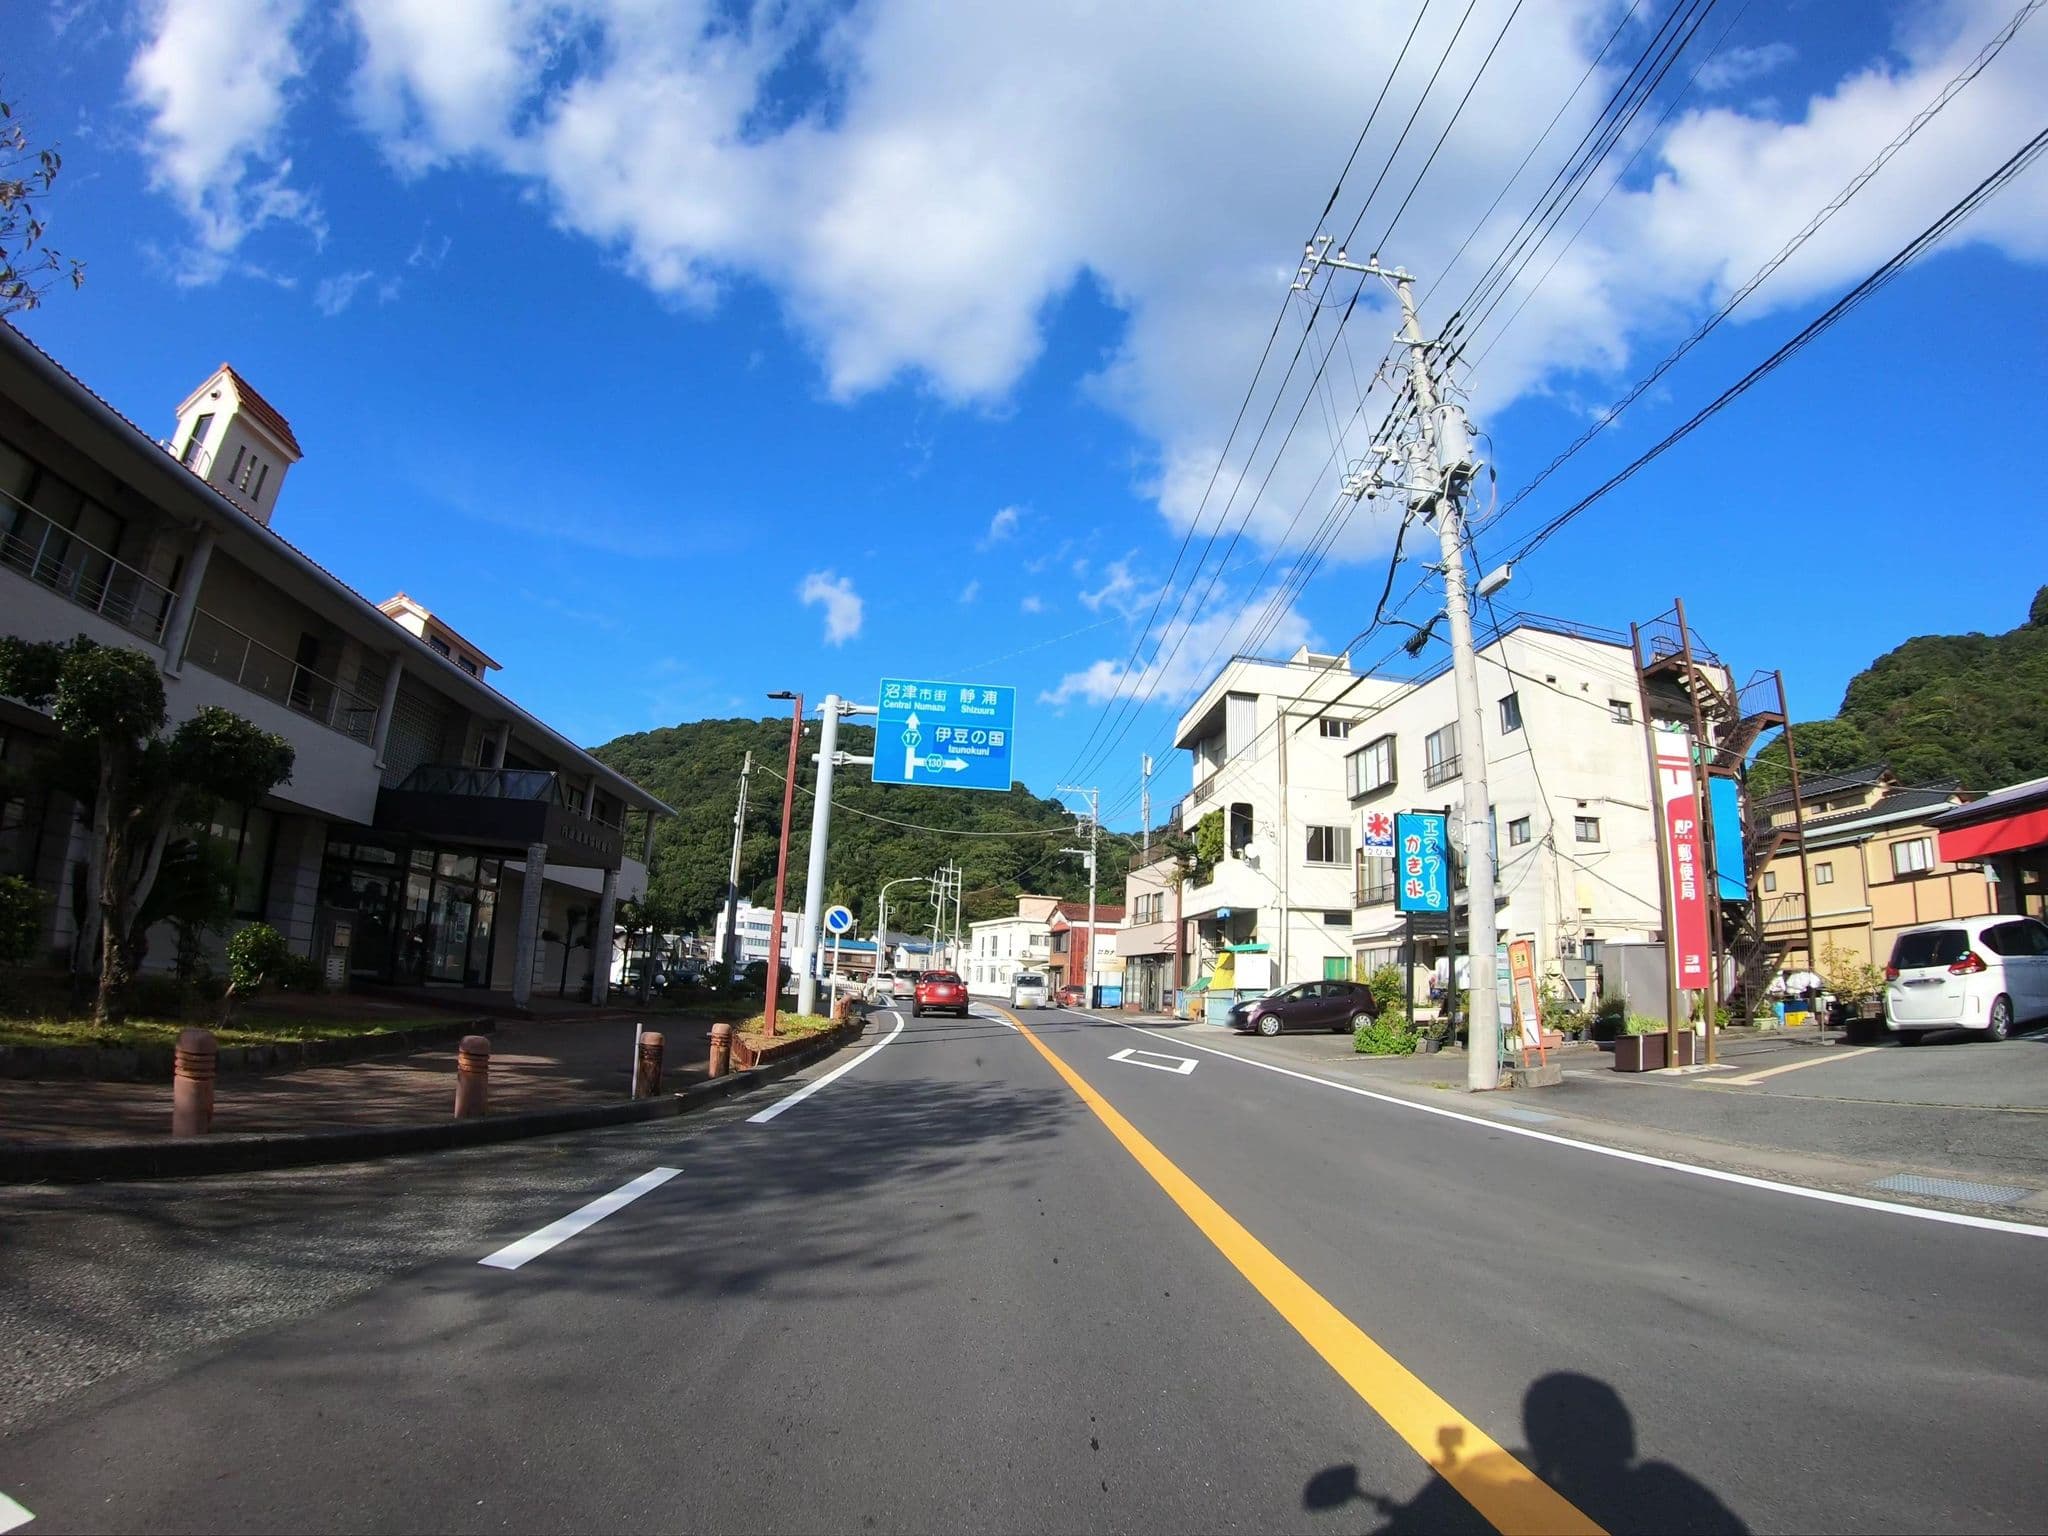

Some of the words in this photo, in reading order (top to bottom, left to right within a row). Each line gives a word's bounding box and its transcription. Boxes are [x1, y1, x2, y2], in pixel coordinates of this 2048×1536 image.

[884, 683, 947, 702] 沼津市街
[960, 688, 997, 705] 静浦
[883, 700, 912, 710] Central
[914, 701, 946, 712] Numazu
[905, 733, 918, 744] 17
[935, 726, 1005, 747] 伊豆の国
[948, 744, 990, 756] Izunokuni
[927, 759, 941, 768] 130
[1367, 812, 1390, 838] 氷
[1405, 834, 1425, 899] かき氷
[1423, 818, 1441, 908] エスプーマ
[1677, 843, 1696, 901] 郵便局
